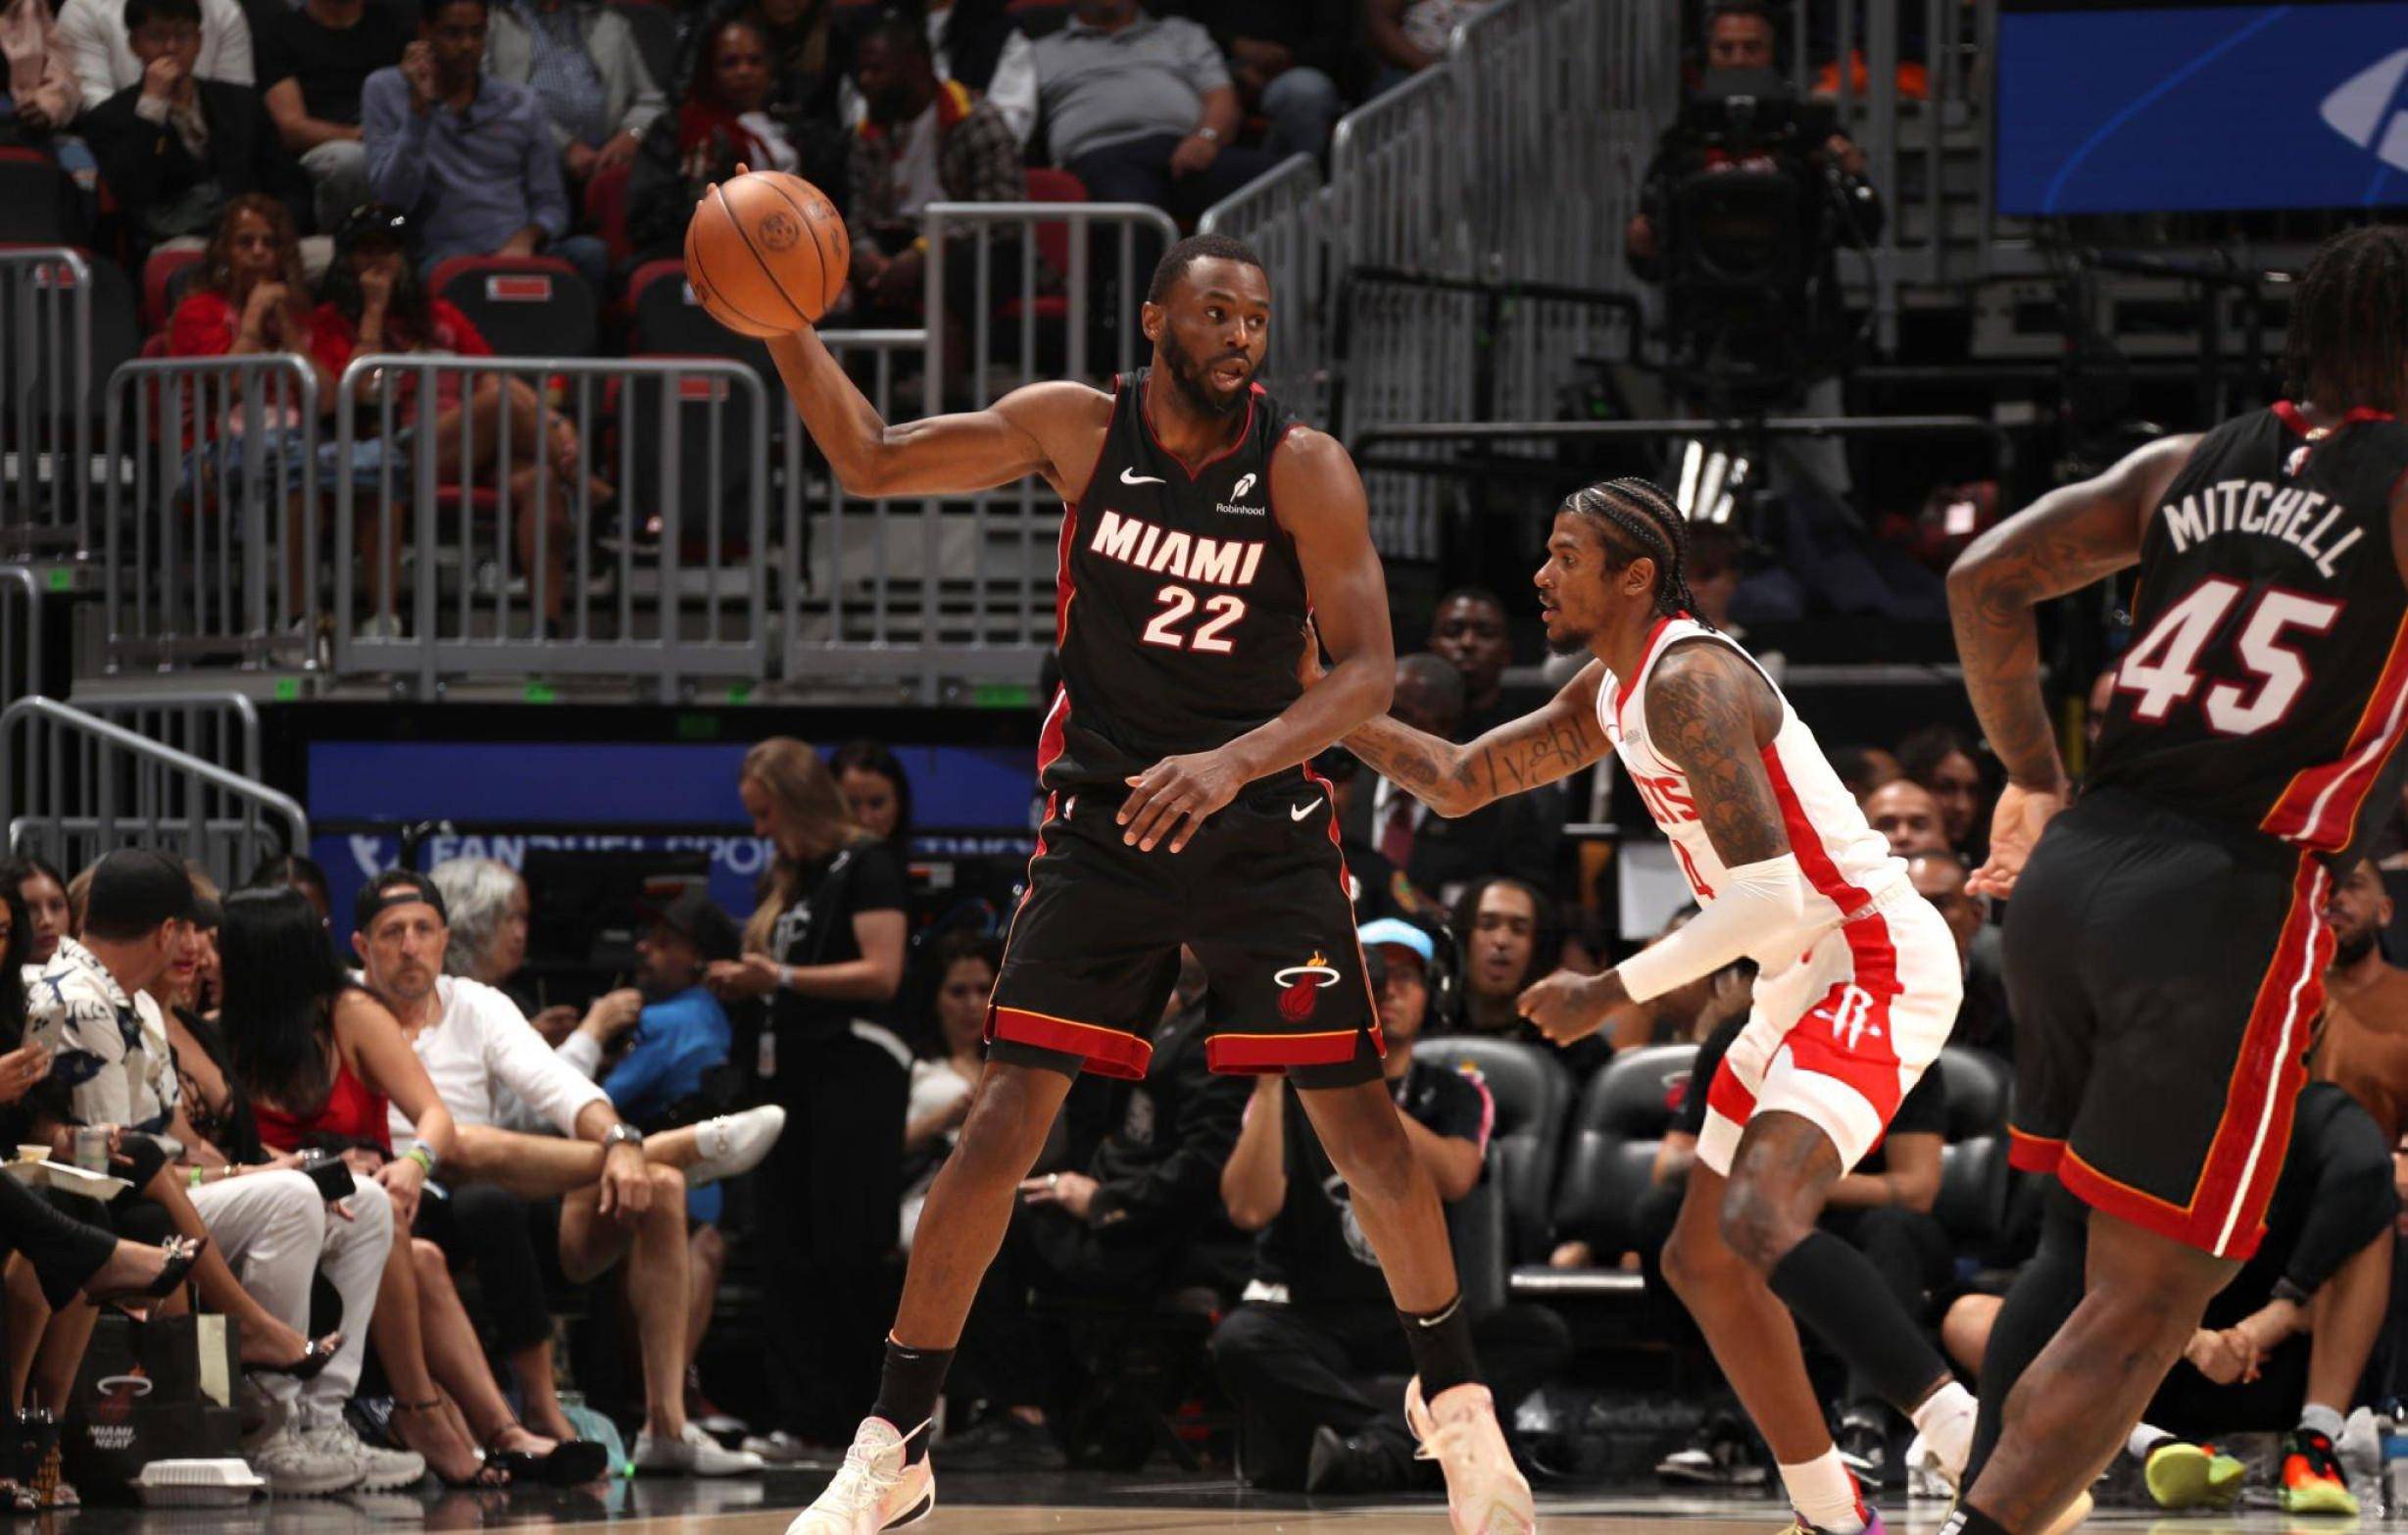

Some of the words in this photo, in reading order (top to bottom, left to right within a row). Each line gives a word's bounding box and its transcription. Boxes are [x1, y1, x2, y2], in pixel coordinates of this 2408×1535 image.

[1216, 503, 1265, 517] Robinhood
[2163, 478, 2366, 578] MITCHELL
[1089, 510, 1265, 587] MIAMI
[1141, 584, 1248, 656] 22
[2113, 574, 2346, 739] 45
[88, 1425, 134, 1438] MIAMI
[95, 1436, 136, 1449] HEAT
